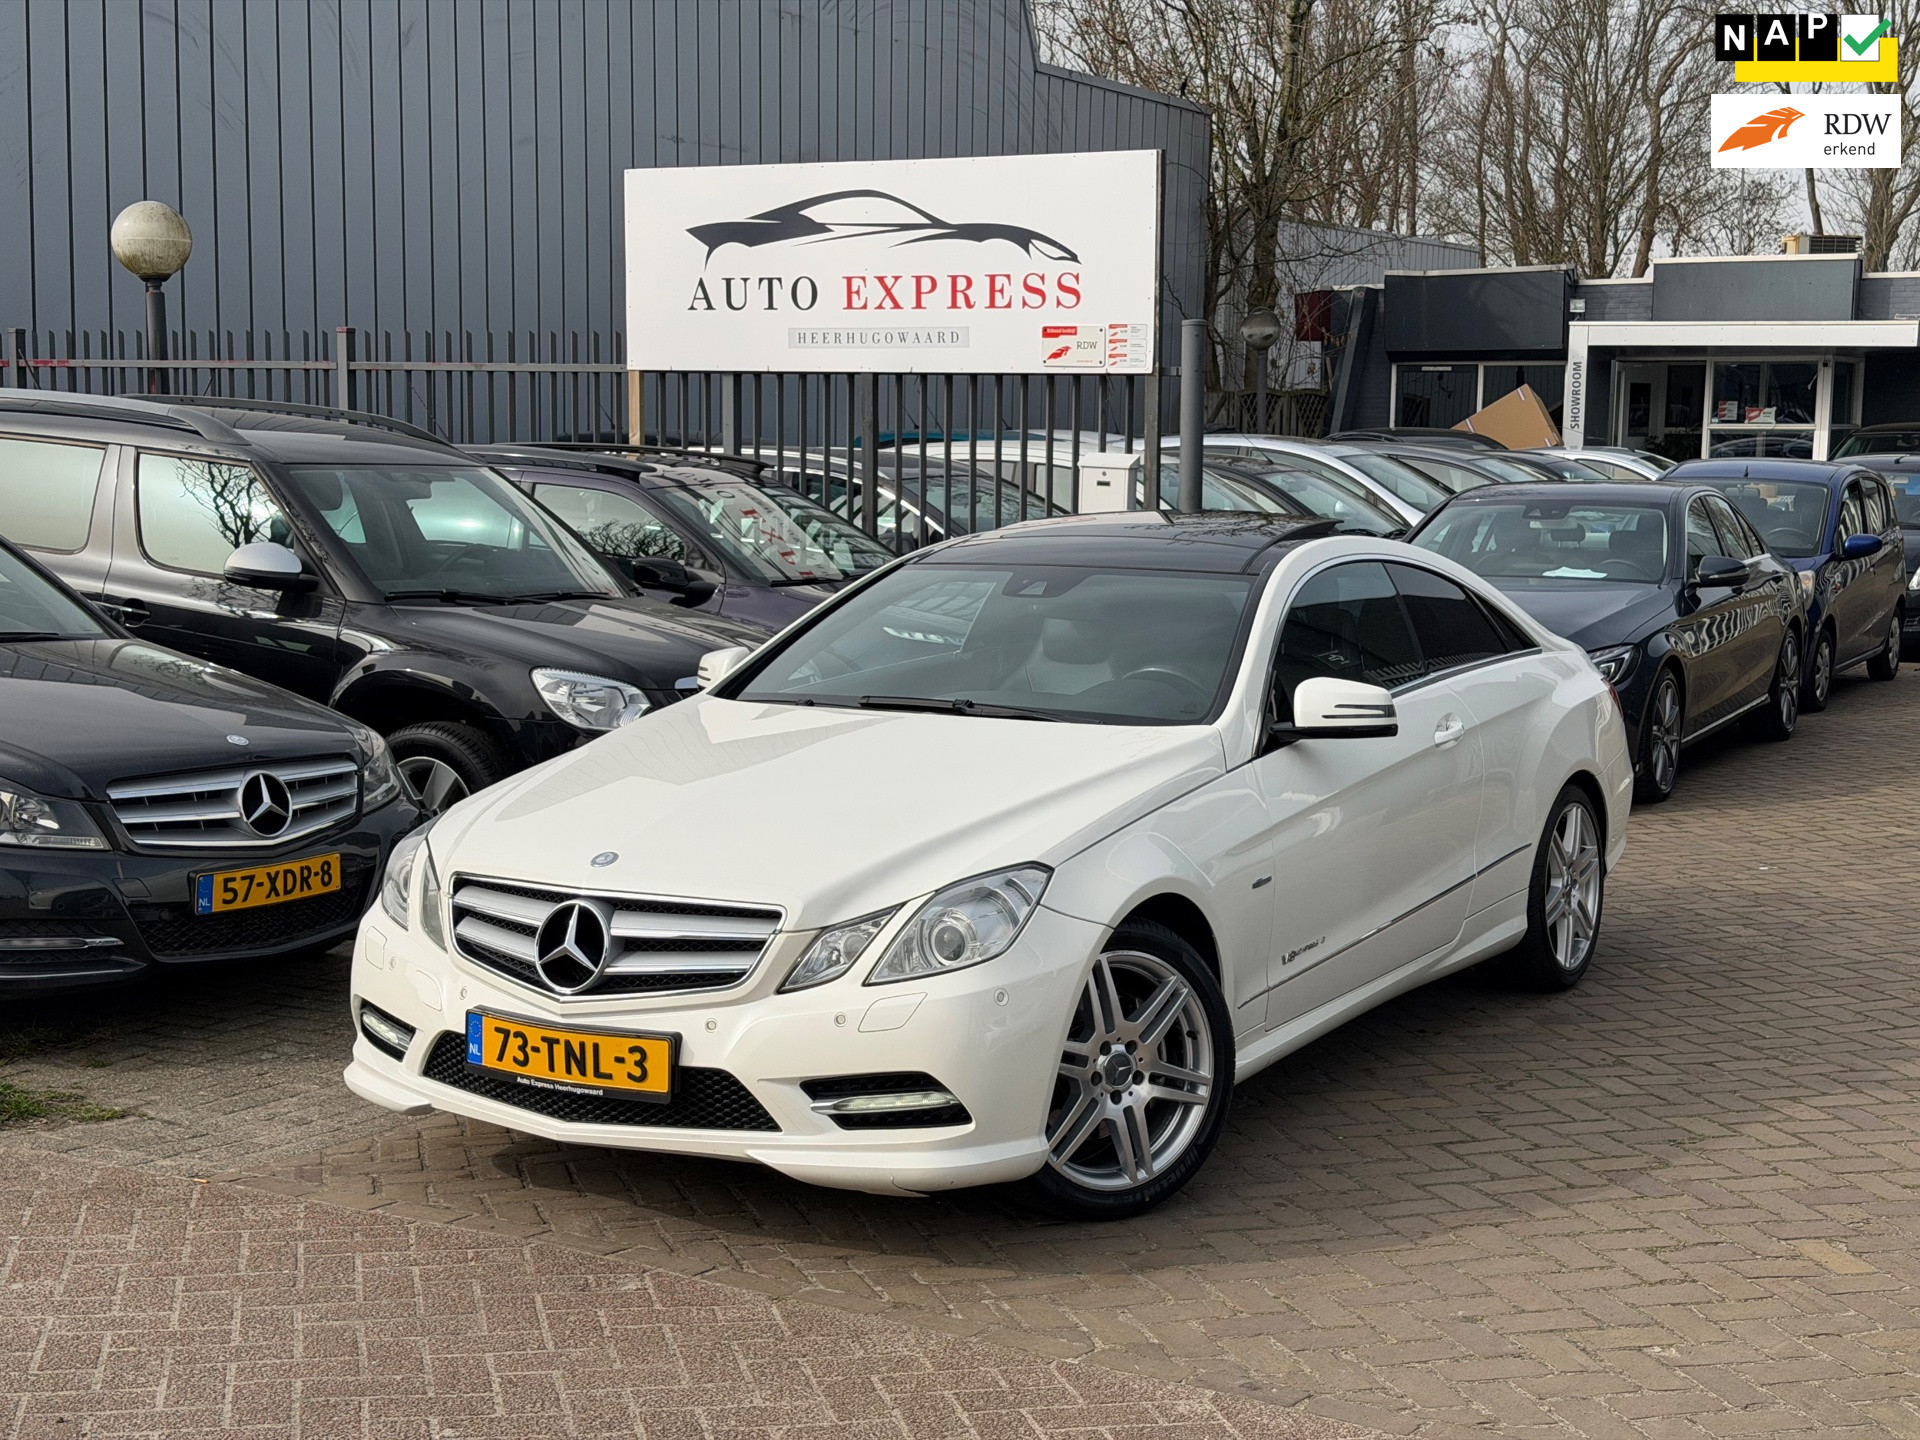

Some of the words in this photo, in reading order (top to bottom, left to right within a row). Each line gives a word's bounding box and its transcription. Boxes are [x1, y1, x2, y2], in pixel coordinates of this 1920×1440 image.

[688, 276, 818, 311] AUTO
[842, 272, 1082, 310] EXPRESS
[797, 331, 960, 346] HEERHUGOWAARD
[1076, 341, 1098, 350] RDW
[1570, 361, 1582, 430] SHOWROOM
[221, 860, 333, 905] 57-XDR-8
[198, 898, 211, 907] NL
[469, 1042, 481, 1056] NL
[493, 1026, 648, 1083] 73-TNL-3
[516, 1076, 530, 1085] Auto
[531, 1079, 554, 1089] Express
[554, 1083, 604, 1096] Heerhugowaard
